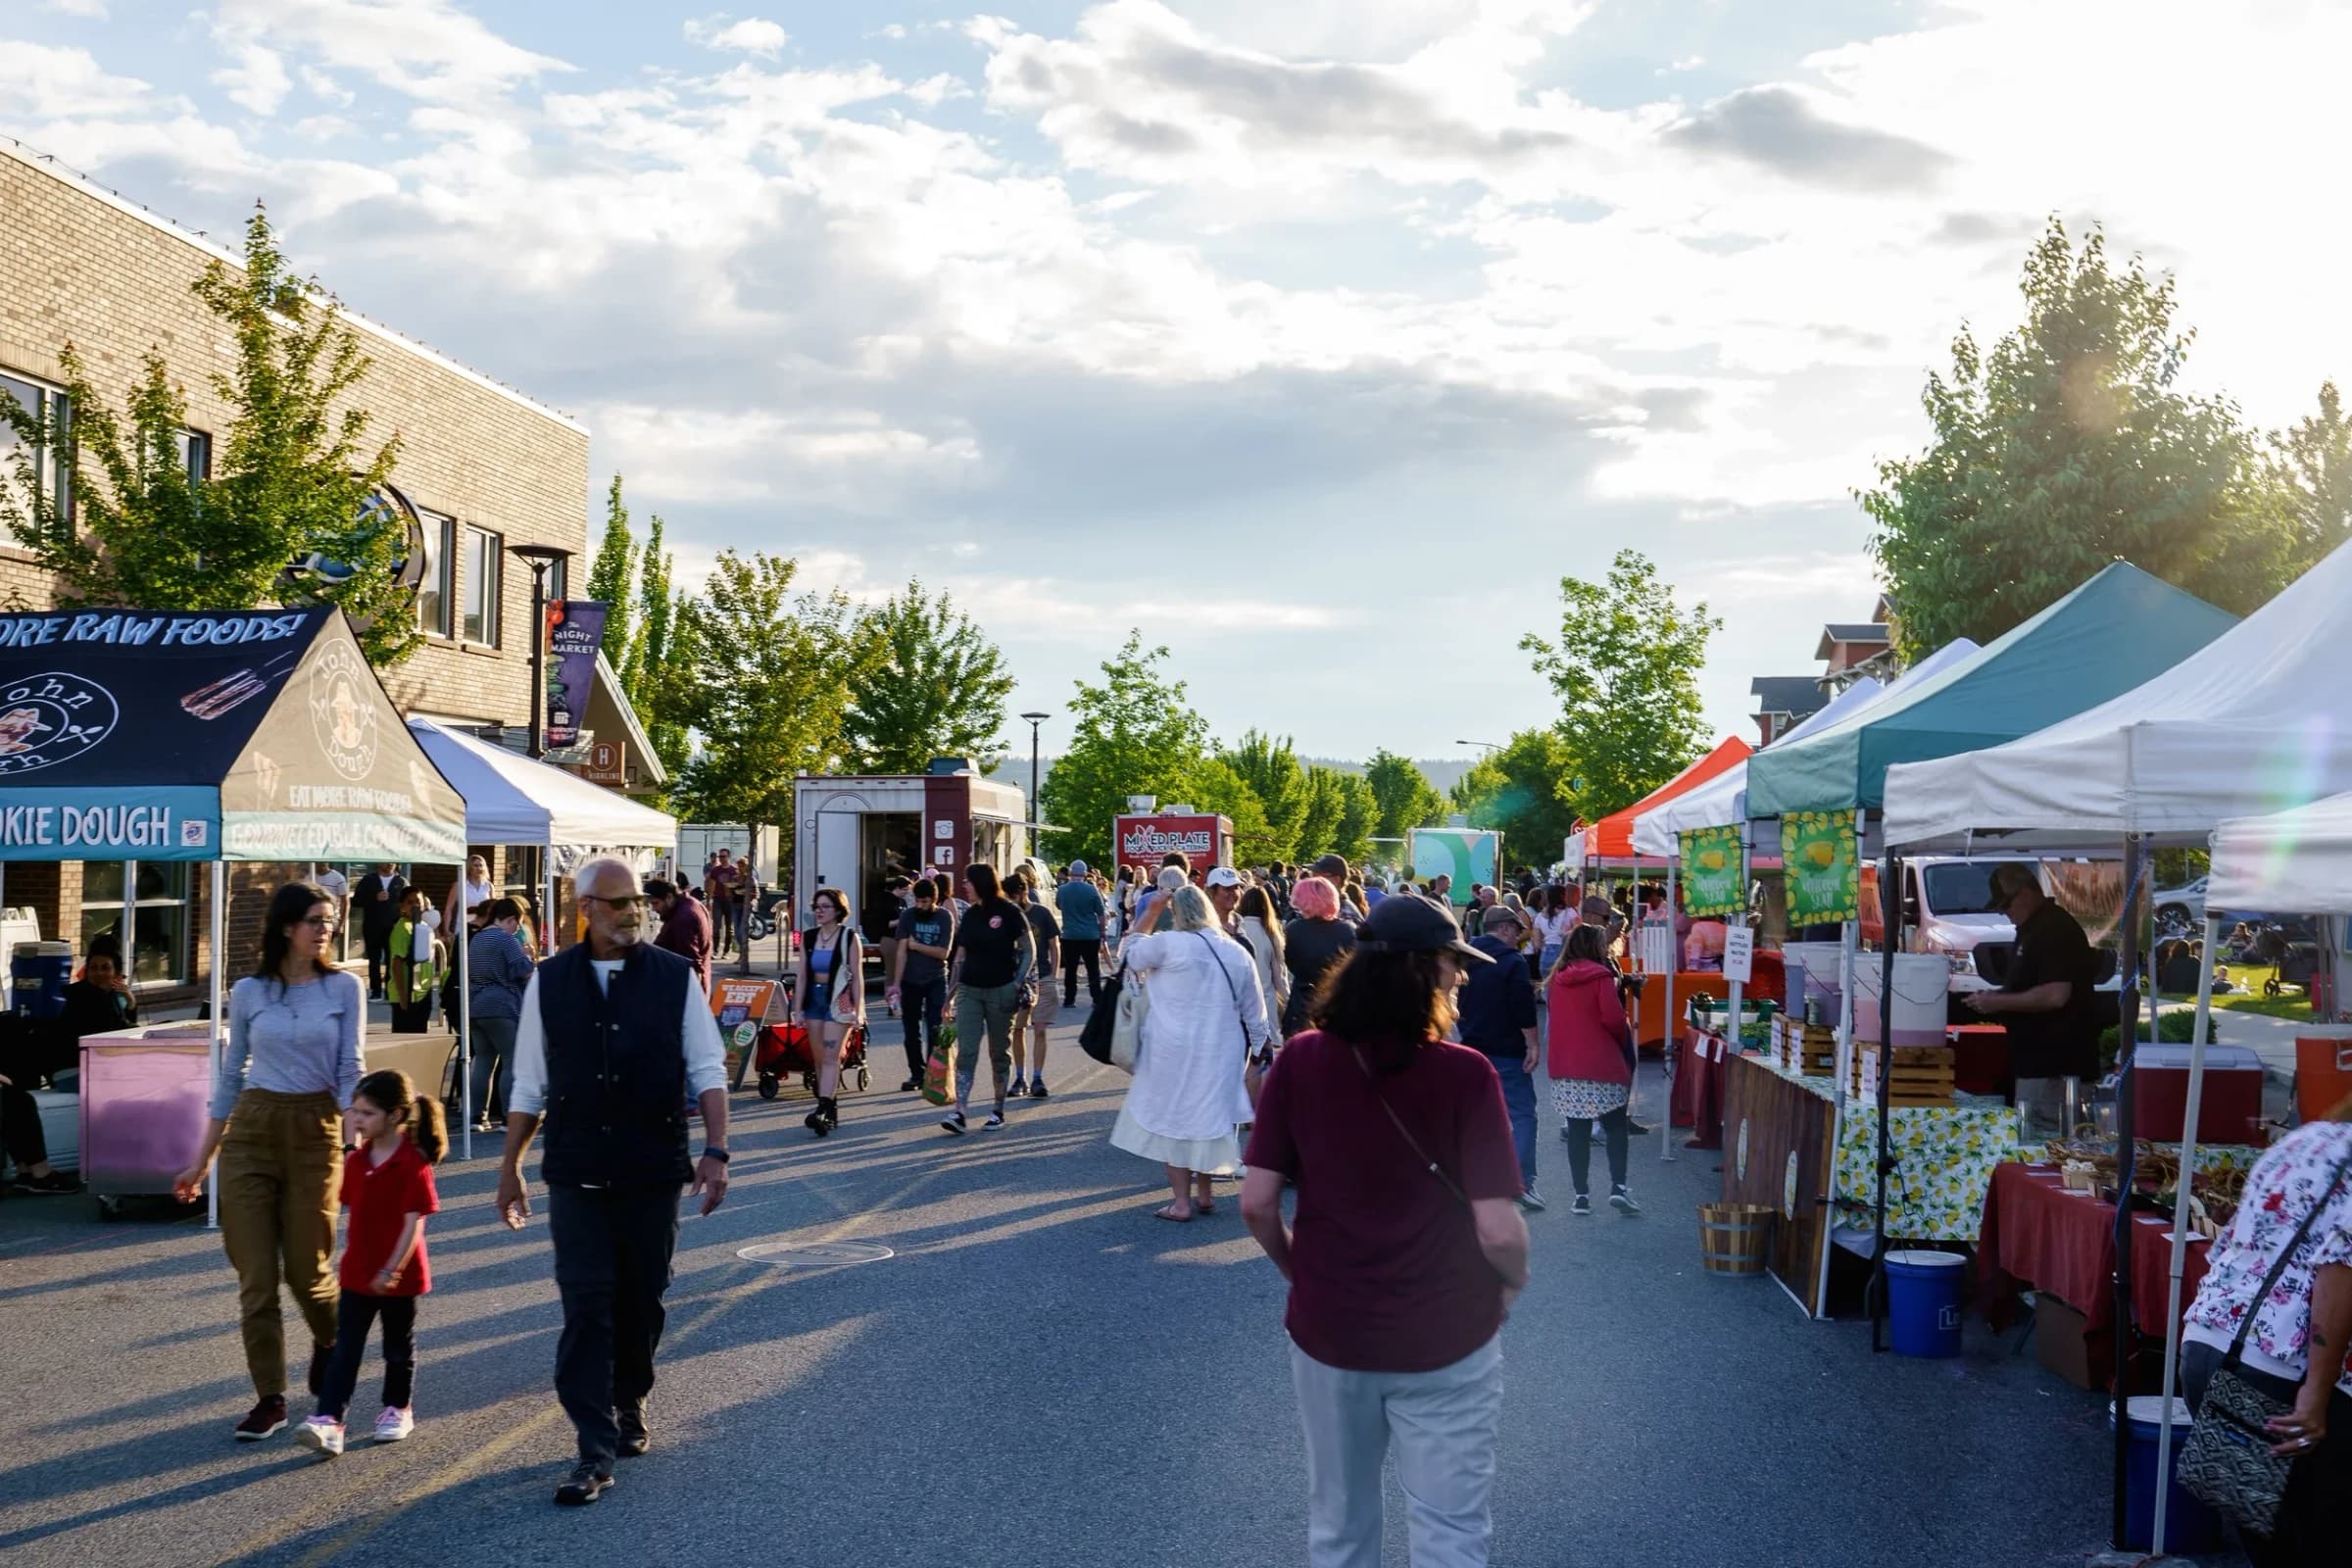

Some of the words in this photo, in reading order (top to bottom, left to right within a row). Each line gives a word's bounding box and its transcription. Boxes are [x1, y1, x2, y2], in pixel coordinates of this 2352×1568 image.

[64, 613, 162, 646] RAW
[161, 613, 308, 645] FOODS!
[555, 630, 592, 643] NIGHT
[551, 644, 595, 654] MARKET
[318, 645, 361, 682] John
[599, 748, 609, 764] H
[289, 784, 311, 808] EAT
[62, 806, 172, 847] DOUGH
[1168, 832, 1209, 845] PLATE
[724, 992, 757, 1004] EBT
